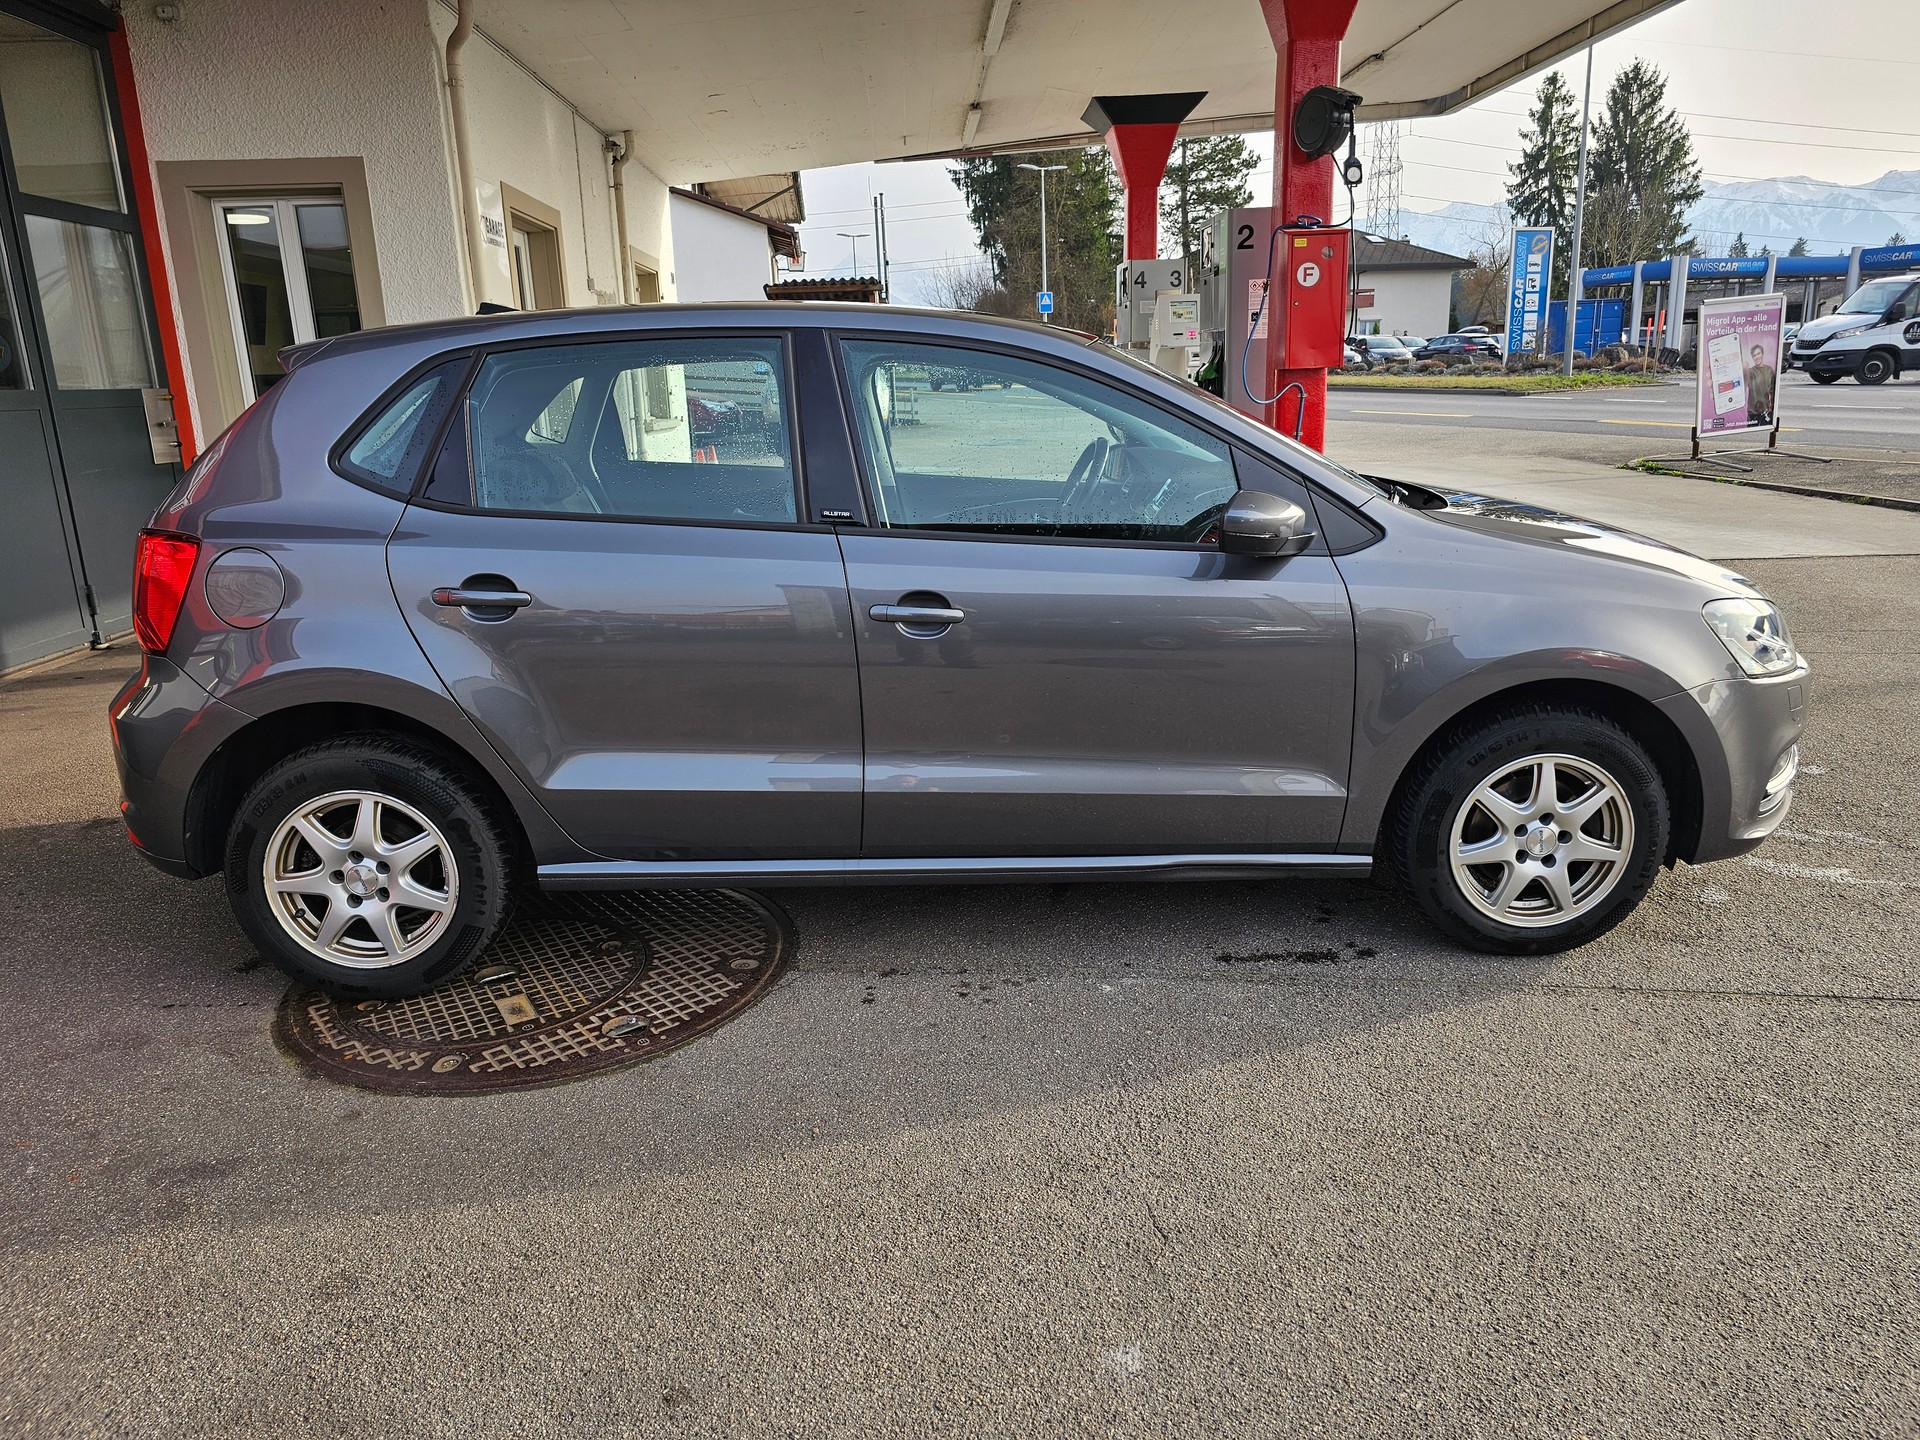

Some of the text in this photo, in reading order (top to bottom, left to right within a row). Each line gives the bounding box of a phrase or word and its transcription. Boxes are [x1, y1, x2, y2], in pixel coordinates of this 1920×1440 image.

[1237, 224, 1254, 250] 2
[1134, 270, 1147, 289] 4
[1170, 270, 1182, 288] 3
[1303, 266, 1315, 282] F
[1706, 315, 1730, 326] Migrol
[1731, 315, 1746, 325] App
[1753, 313, 1767, 322] alle
[1706, 322, 1778, 336] Vorteile in der Hand
